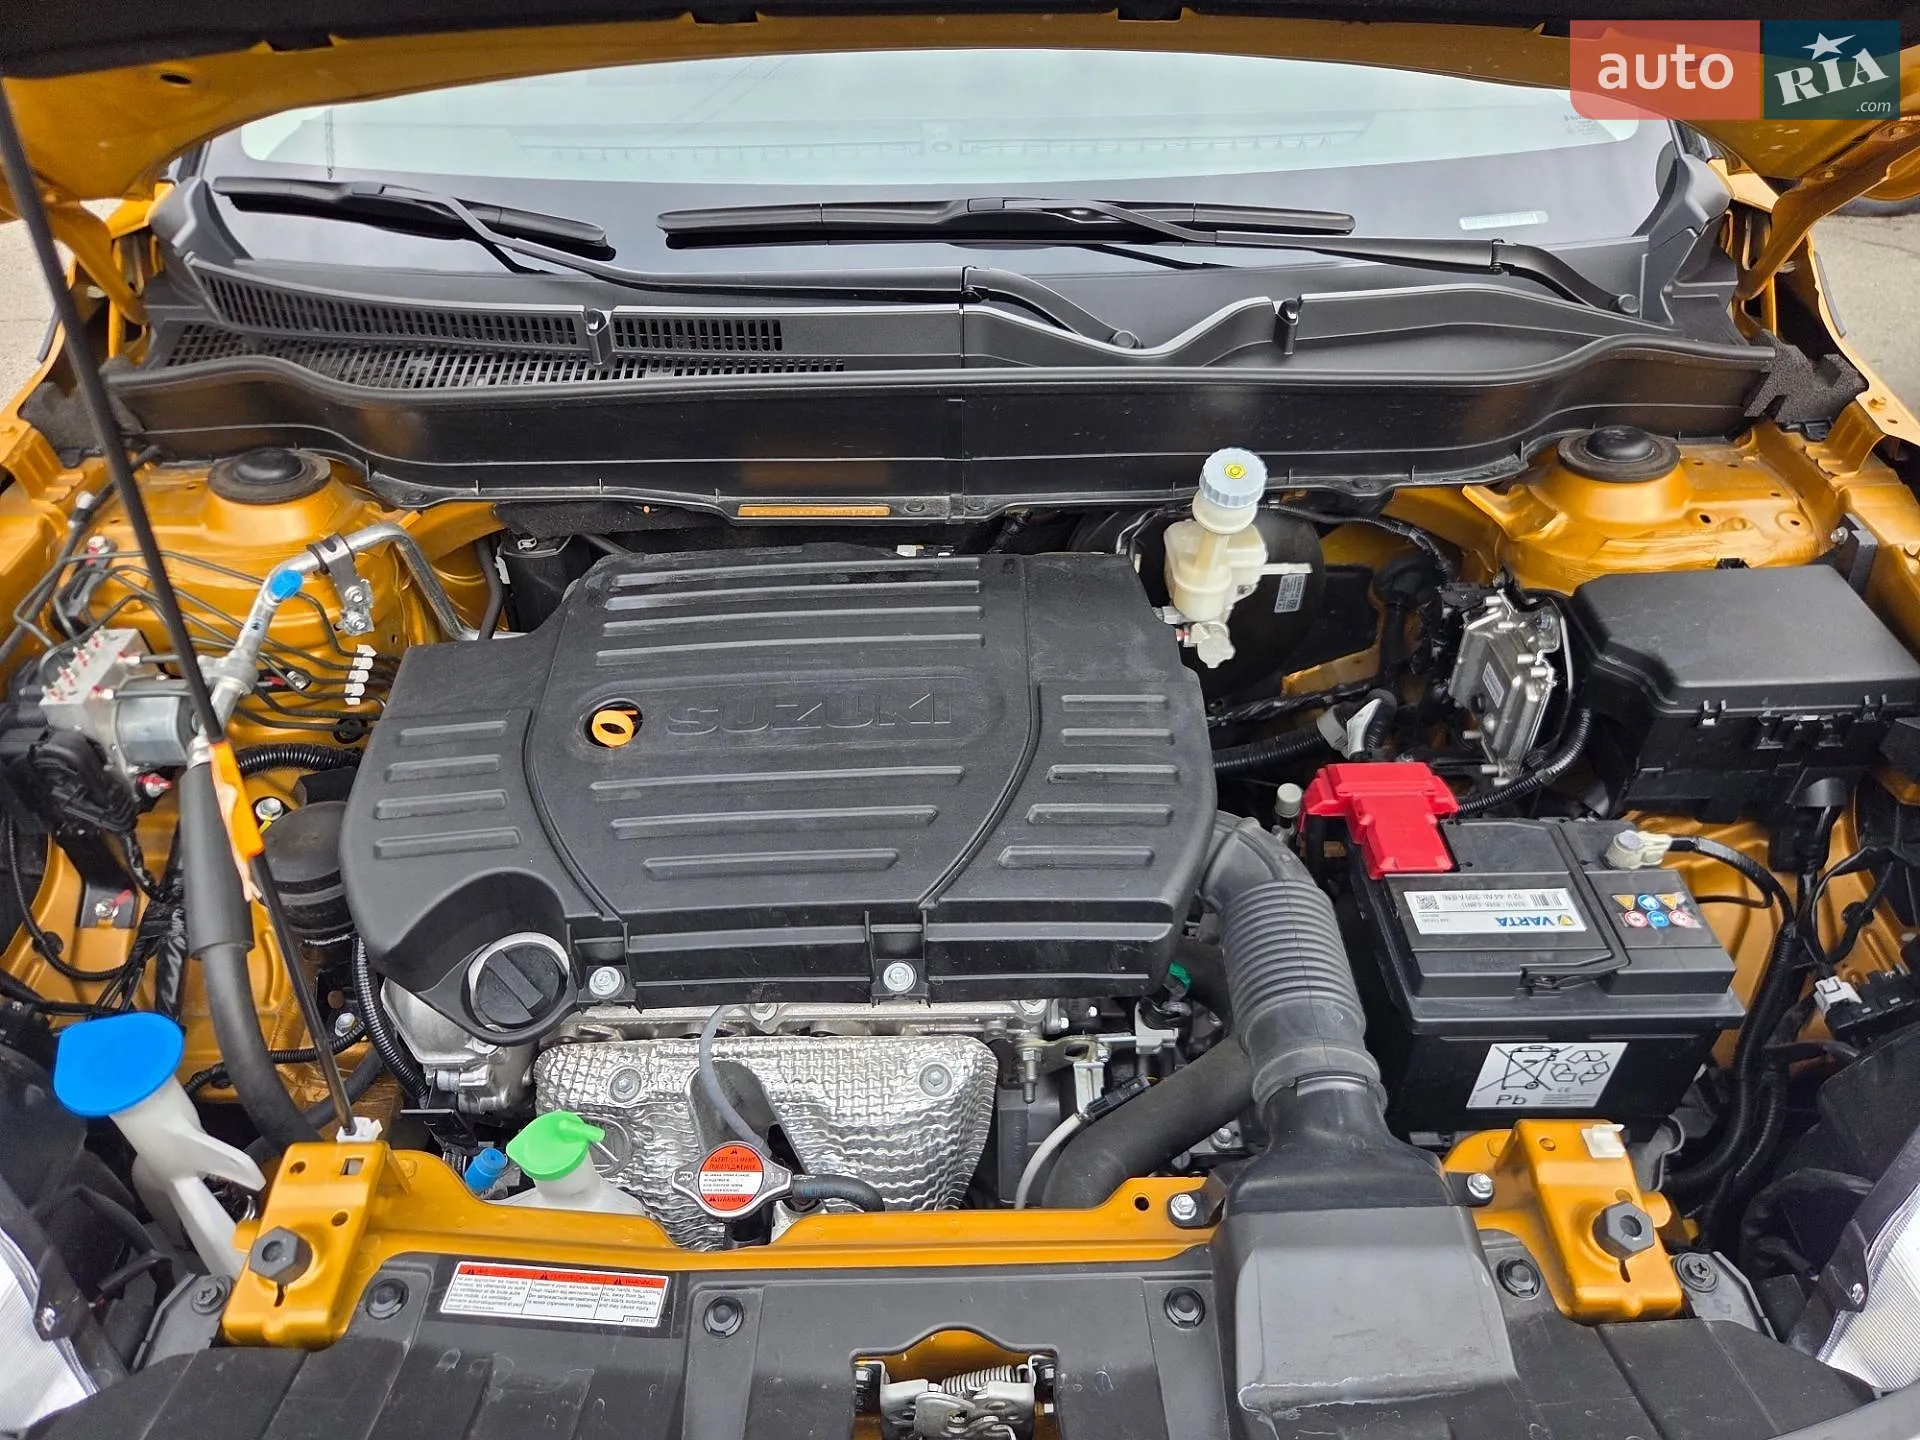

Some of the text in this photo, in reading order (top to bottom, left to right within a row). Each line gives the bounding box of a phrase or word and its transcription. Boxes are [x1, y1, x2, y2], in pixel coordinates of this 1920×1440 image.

[665, 691, 953, 736] SUZUKI
[1495, 916, 1556, 928] VARTA
[1495, 1094, 1528, 1106] Pb
